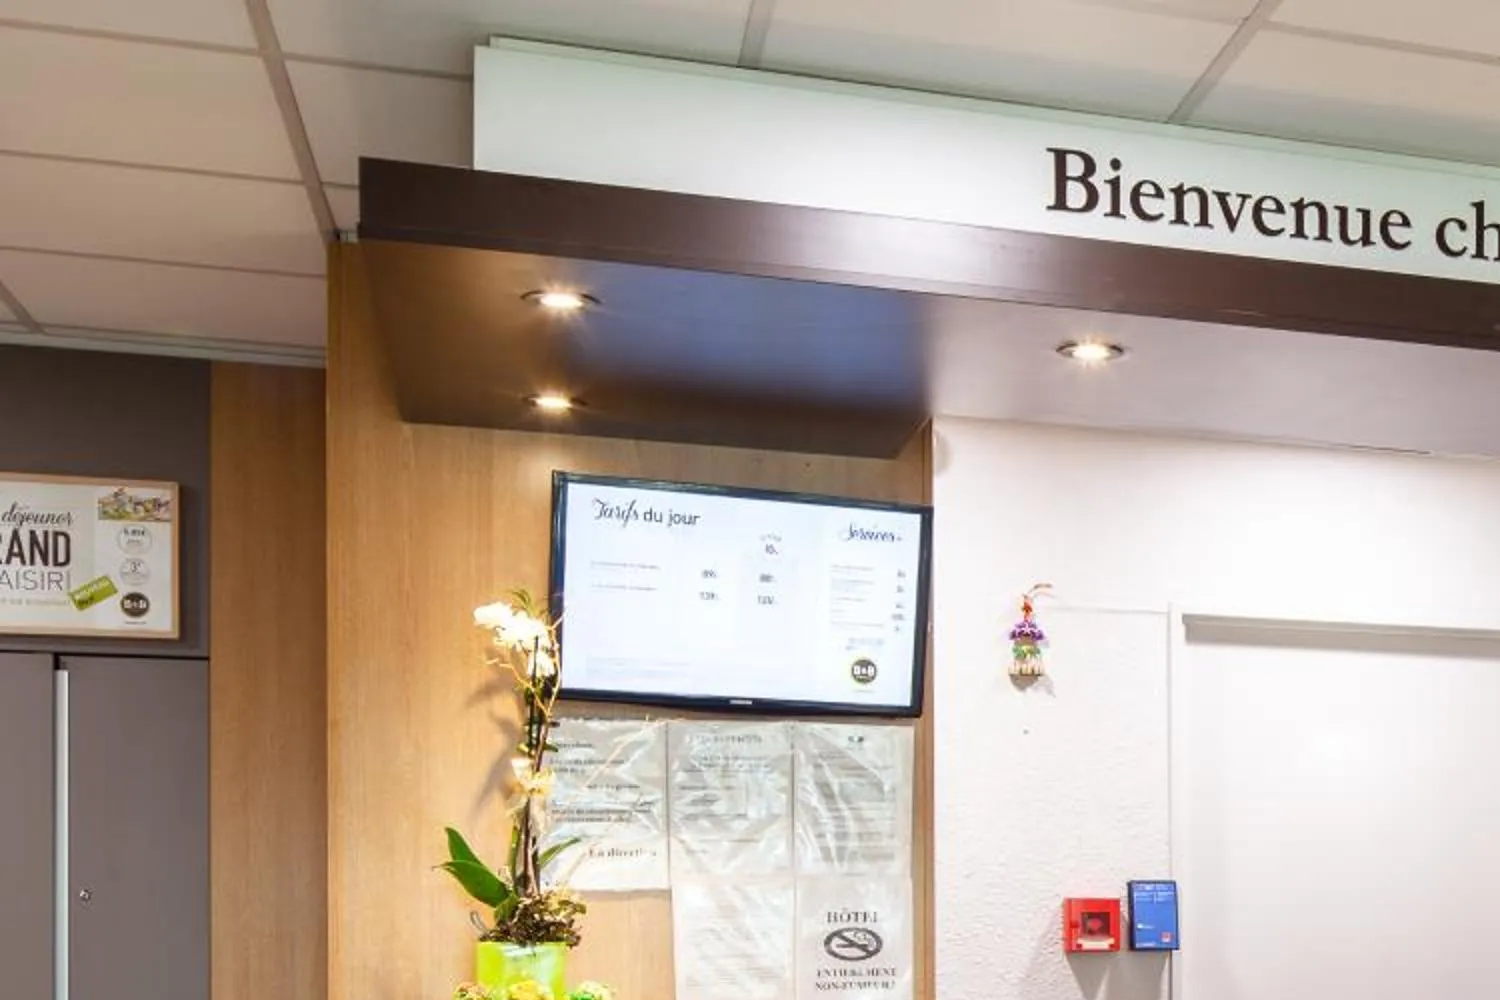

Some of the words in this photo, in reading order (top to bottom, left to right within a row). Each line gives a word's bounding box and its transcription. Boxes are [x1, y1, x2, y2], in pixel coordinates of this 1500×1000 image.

[1046, 146, 1413, 251] Bienvenue
[593, 498, 639, 529] Tarifs
[643, 507, 663, 524] du
[667, 508, 702, 528] jour
[0, 527, 71, 568] AND
